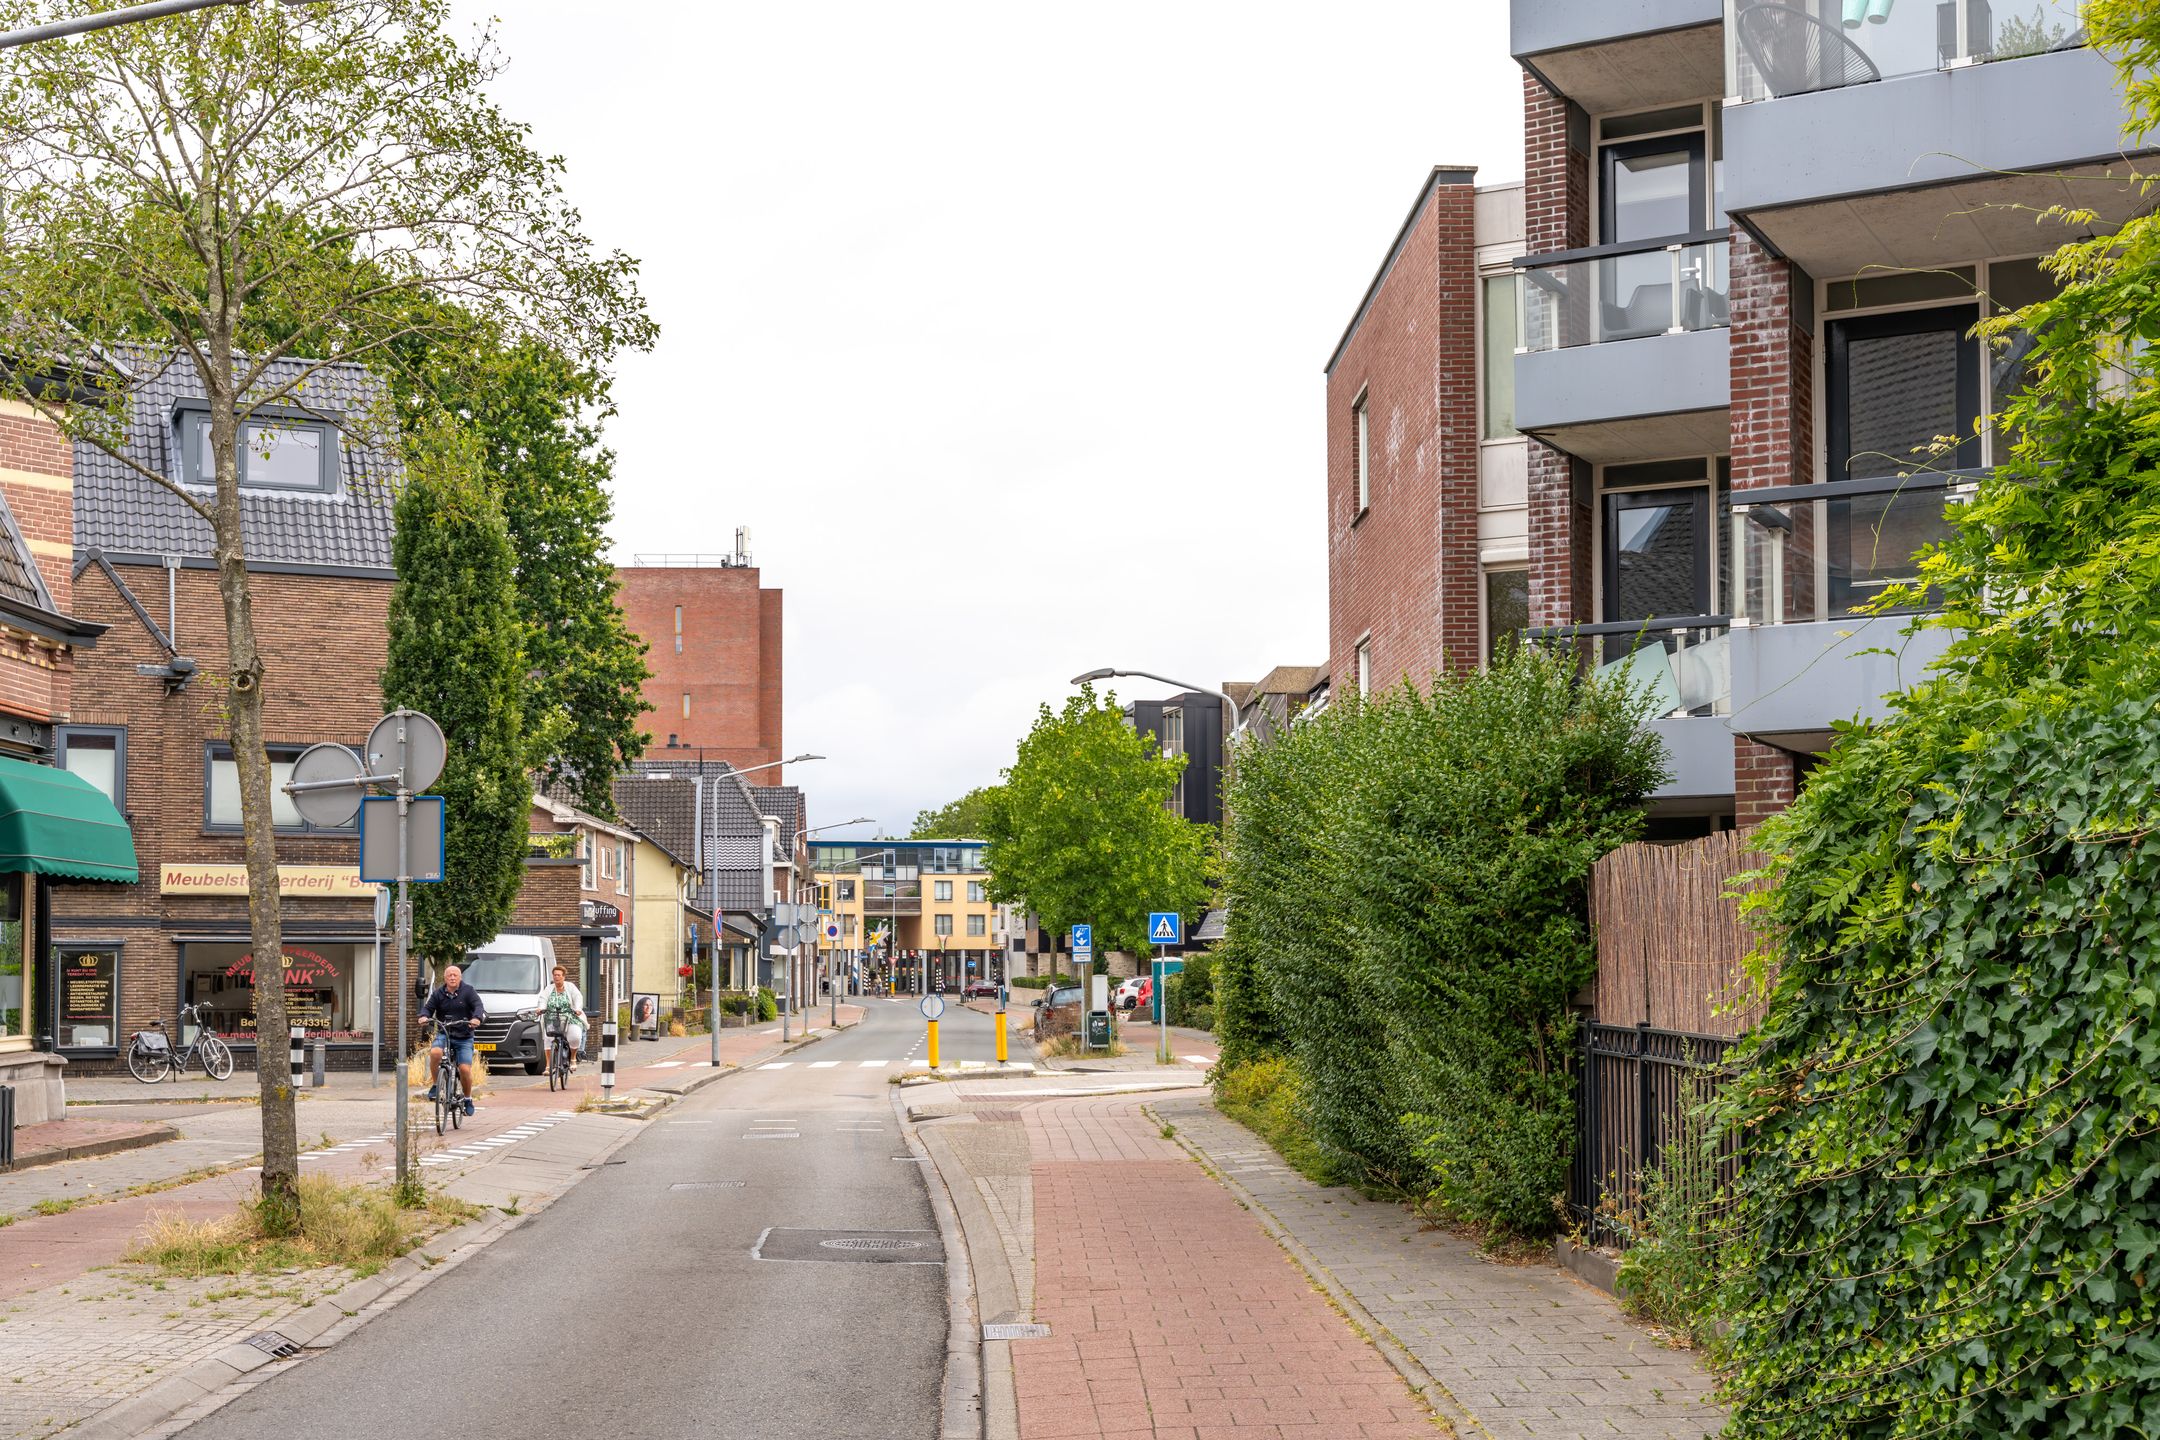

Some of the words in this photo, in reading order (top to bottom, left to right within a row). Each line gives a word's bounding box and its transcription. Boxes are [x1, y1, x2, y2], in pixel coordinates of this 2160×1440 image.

[166, 872, 334, 890] Meubelsterderij
[593, 905, 617, 917] uffing
[290, 1018, 330, 1027] 6243315
